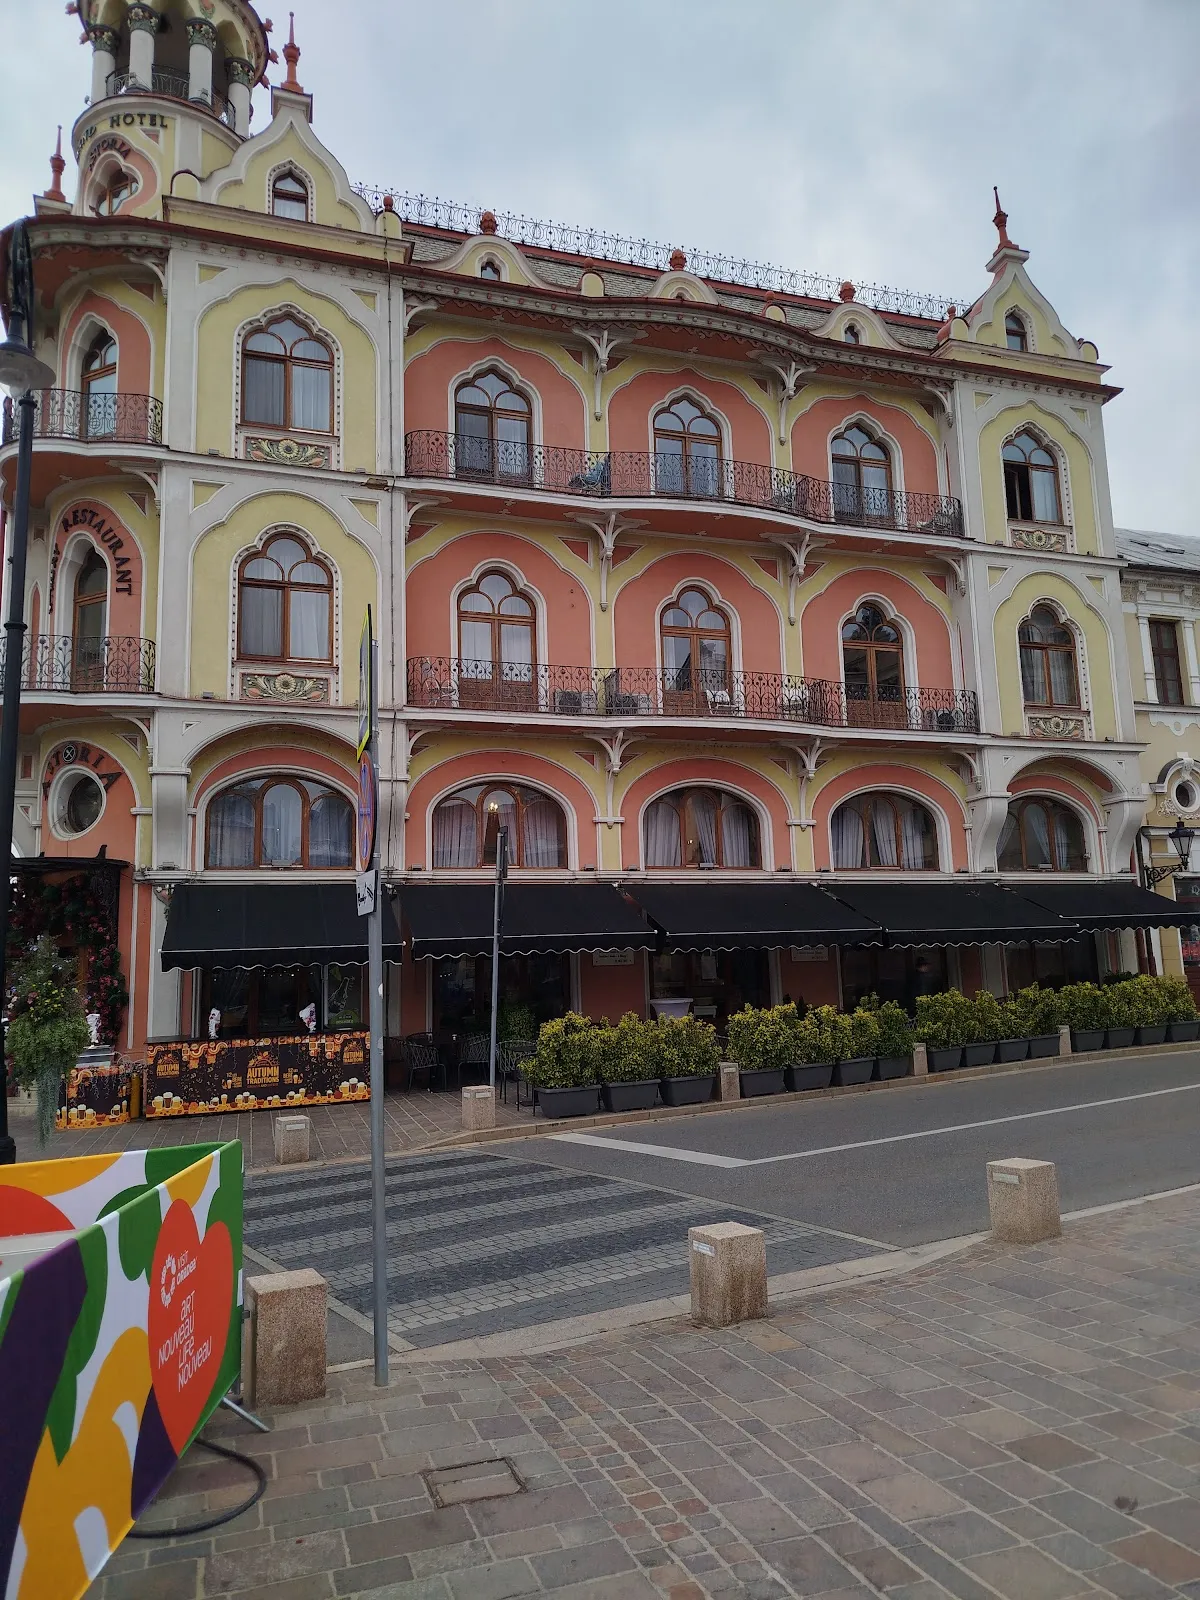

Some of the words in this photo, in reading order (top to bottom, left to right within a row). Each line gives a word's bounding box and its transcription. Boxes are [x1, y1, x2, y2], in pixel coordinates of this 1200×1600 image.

[110, 113, 168, 128] HOTEL
[61, 508, 133, 596] RESTAURANT
[157, 1063, 180, 1071] AUTUMN
[247, 1066, 280, 1078] AUTUMN
[246, 1077, 280, 1085] TRADITIONS
